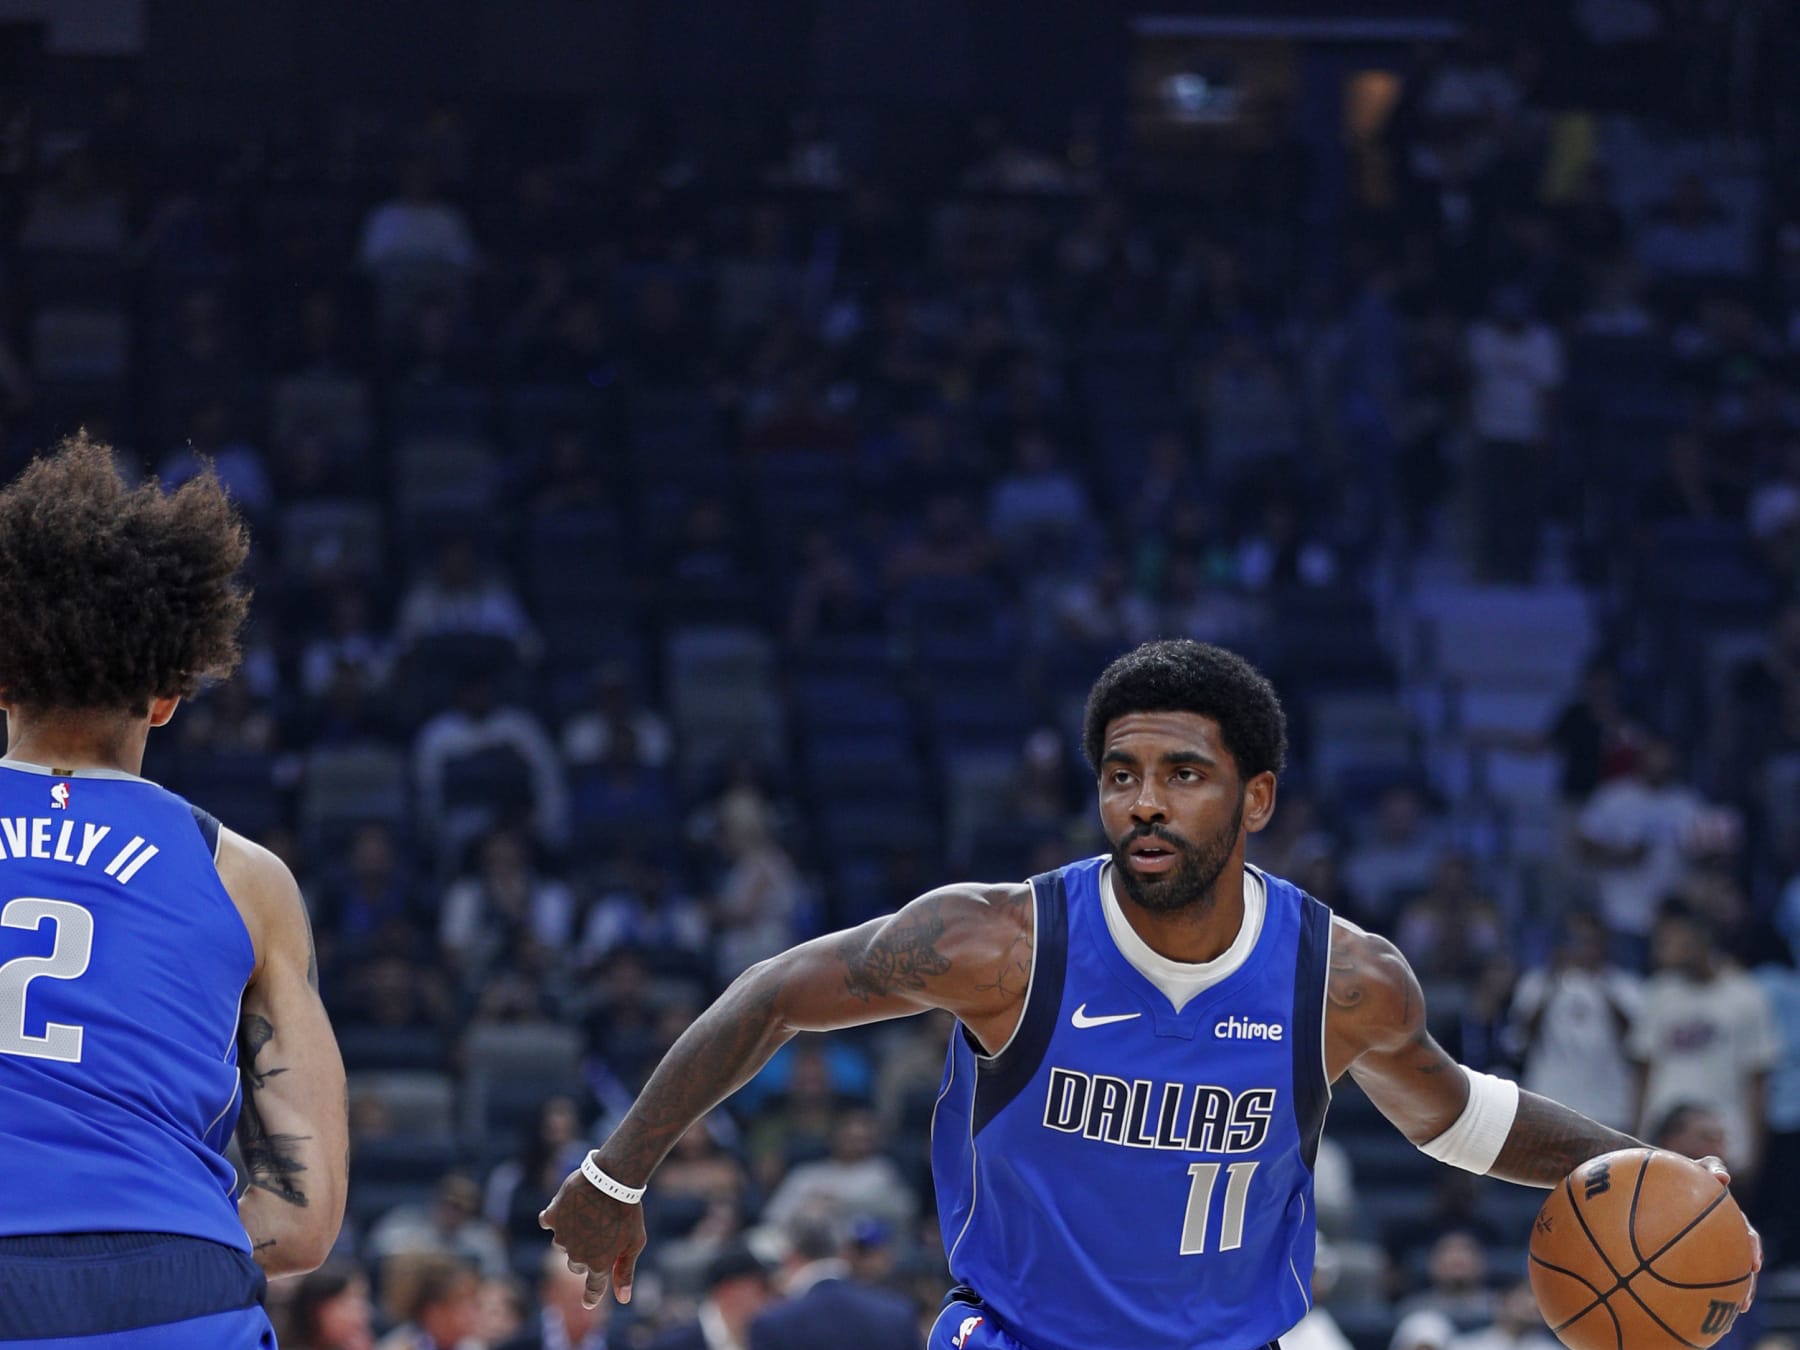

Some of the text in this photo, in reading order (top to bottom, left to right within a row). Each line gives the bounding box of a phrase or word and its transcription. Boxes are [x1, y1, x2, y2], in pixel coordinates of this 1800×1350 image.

[0, 897, 94, 1063] 2
[1214, 1015, 1283, 1041] chime
[1043, 1067, 1276, 1153] DALLAS
[1180, 1162, 1260, 1255] 11
